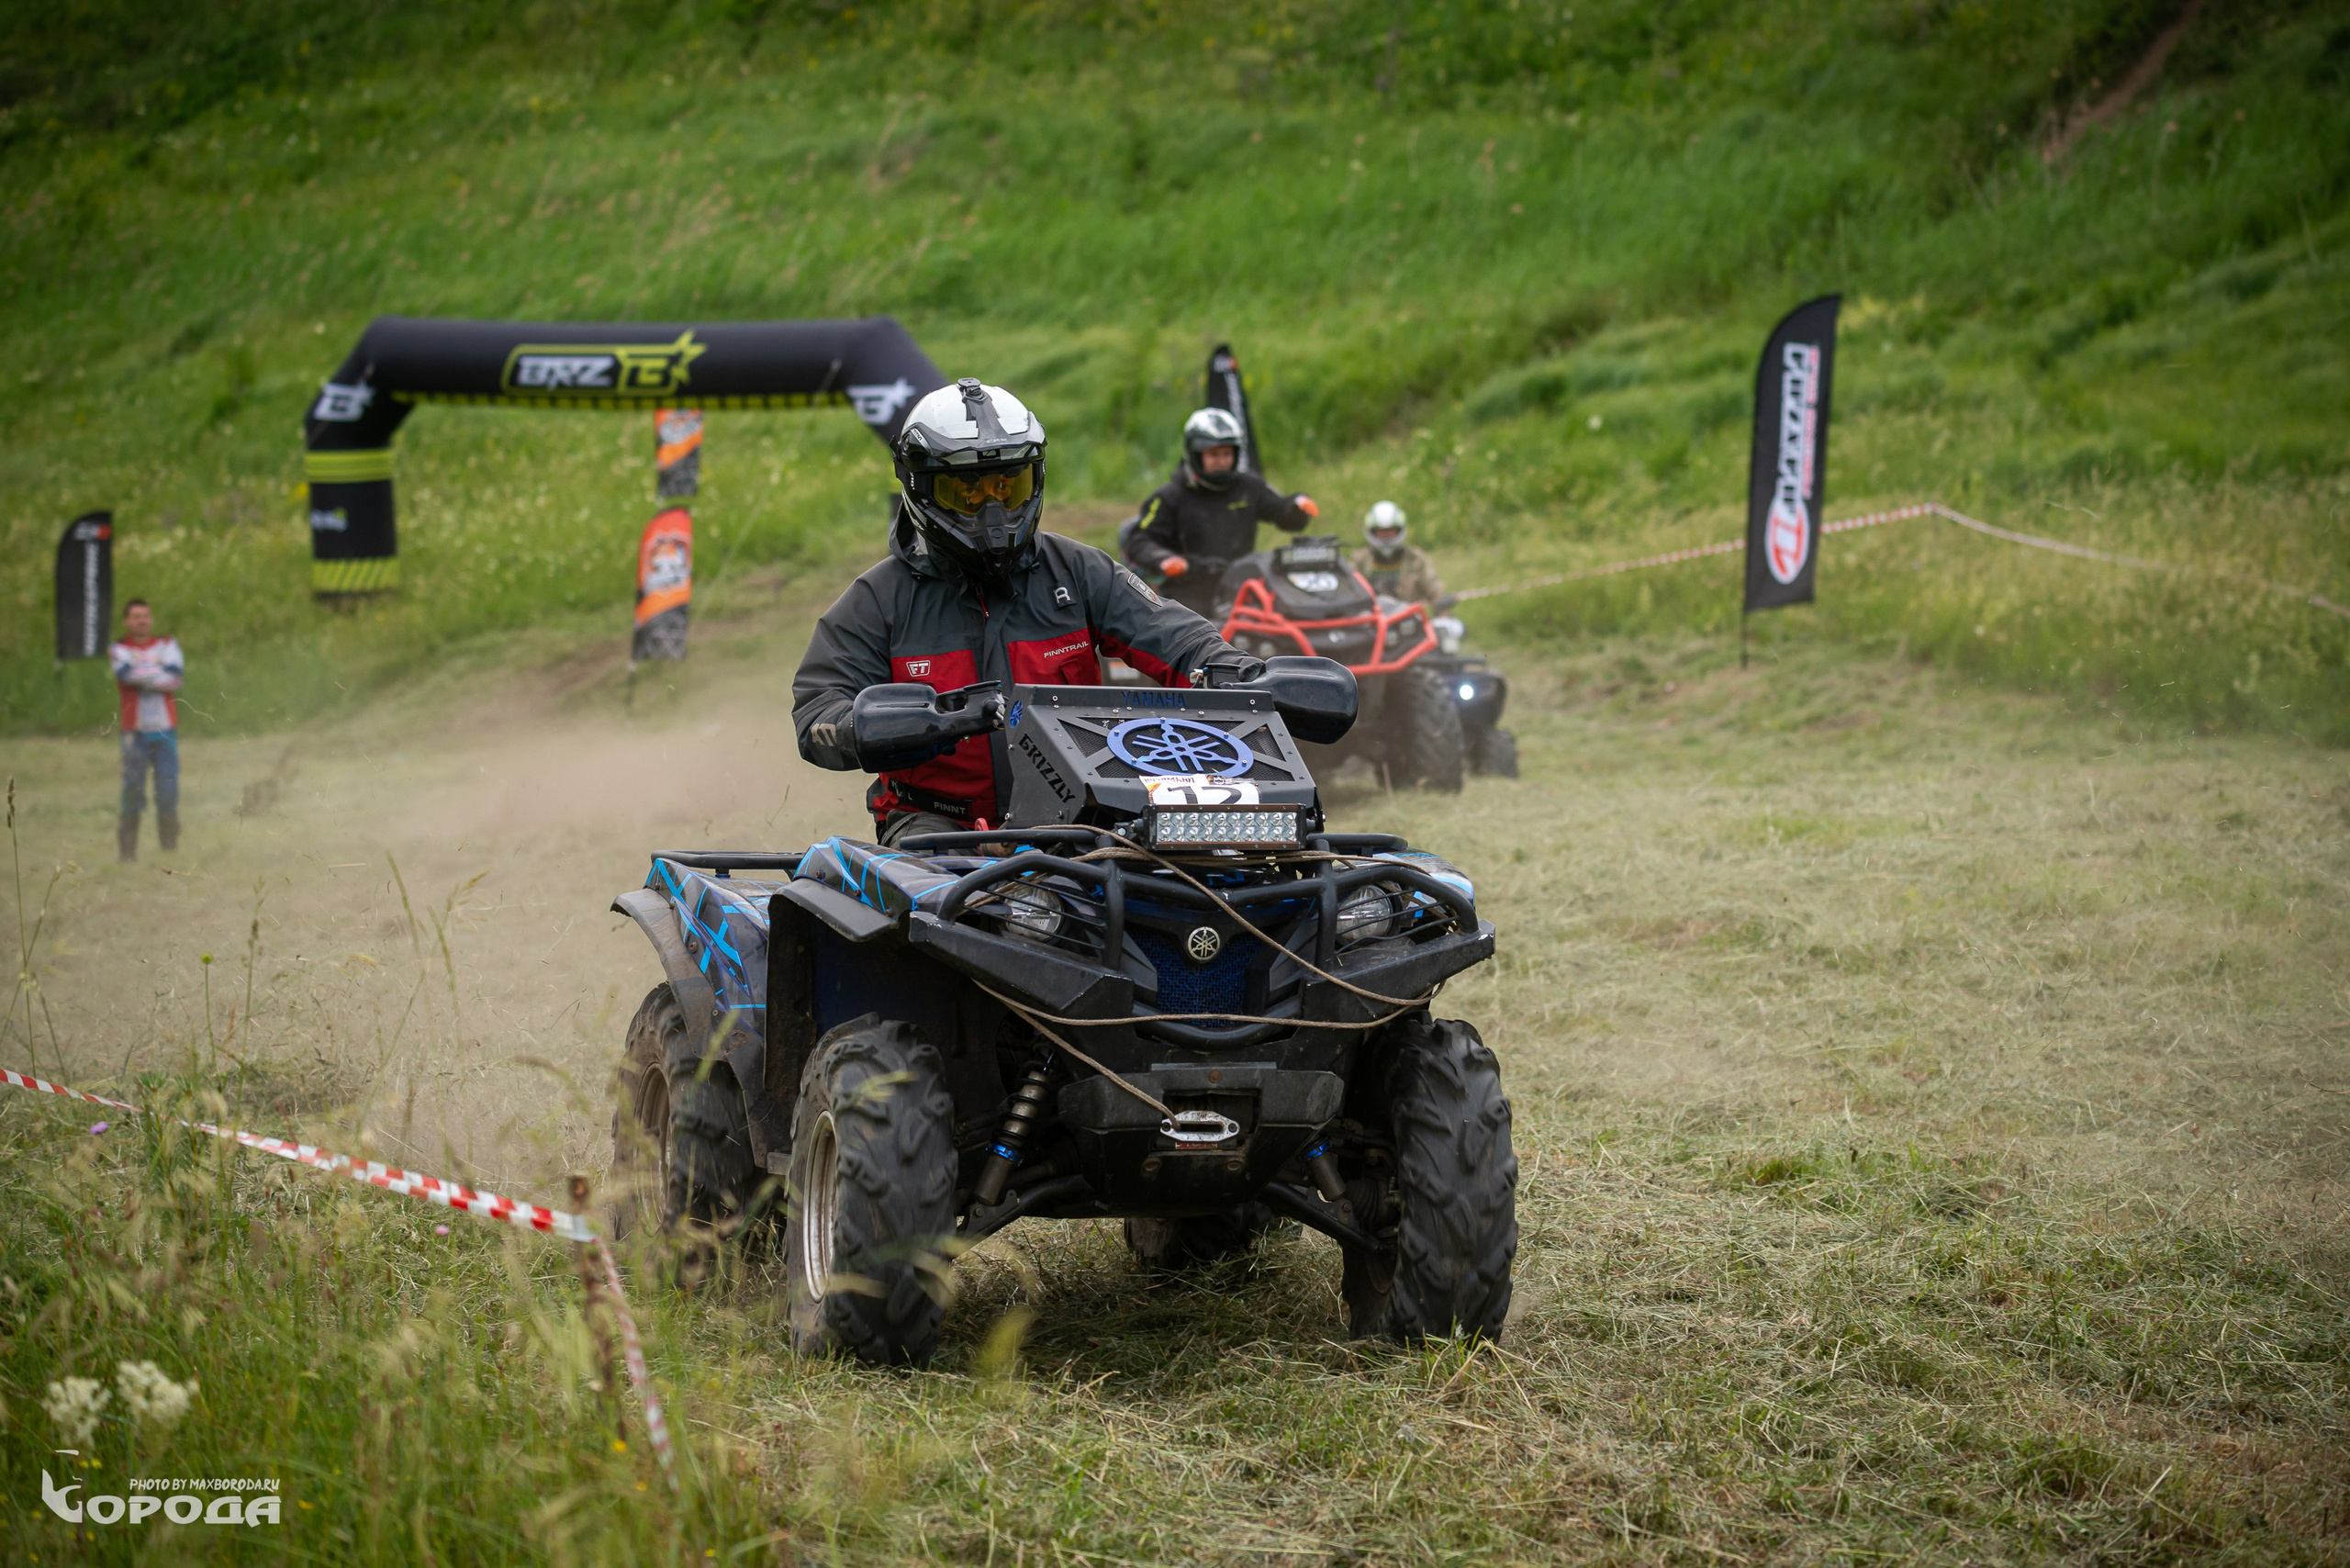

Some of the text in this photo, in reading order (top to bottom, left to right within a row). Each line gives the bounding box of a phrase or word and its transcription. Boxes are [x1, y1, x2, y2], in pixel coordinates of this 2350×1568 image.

[1044, 641, 1090, 658] FINNTRAIL
[909, 663, 929, 675] FT
[1121, 690, 1186, 707] YAMAHA
[1018, 733, 1076, 803] GRIZZLY
